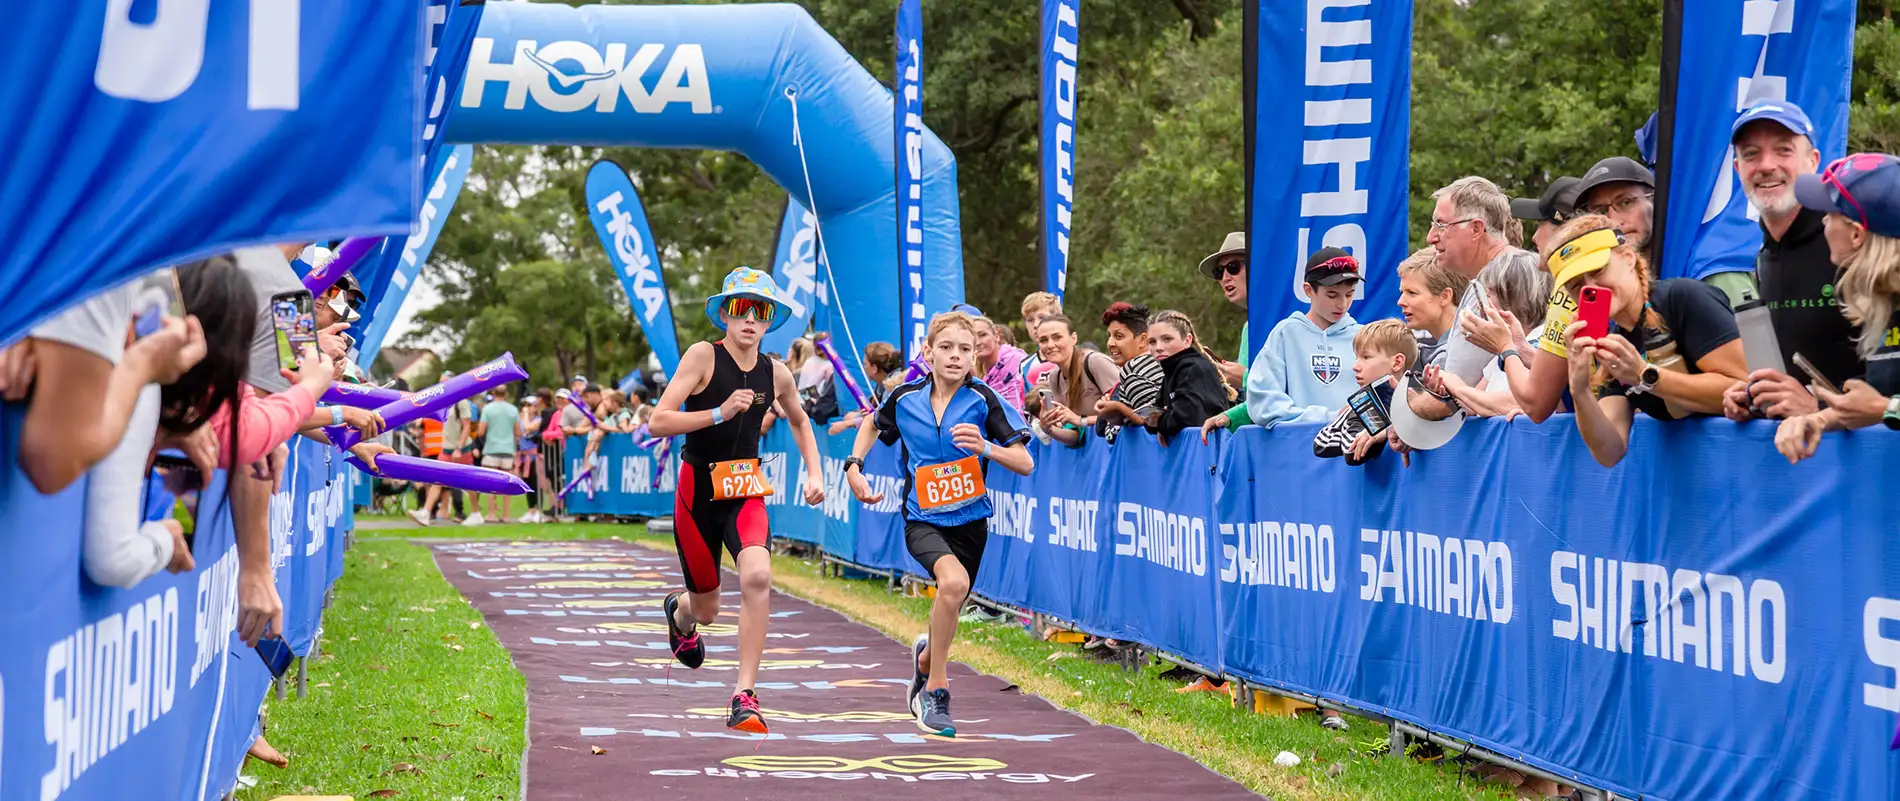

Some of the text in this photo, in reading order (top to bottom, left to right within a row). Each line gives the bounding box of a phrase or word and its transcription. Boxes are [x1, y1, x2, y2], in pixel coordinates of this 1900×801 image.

[460, 38, 713, 113] HOKA
[596, 190, 665, 323] HOKA
[926, 473, 975, 504] 6295
[1115, 501, 1206, 577] SHIMANO
[1219, 521, 1336, 593] SHIMANO
[1550, 550, 1786, 684] SHIMANO
[40, 586, 179, 801] SHIMANO
